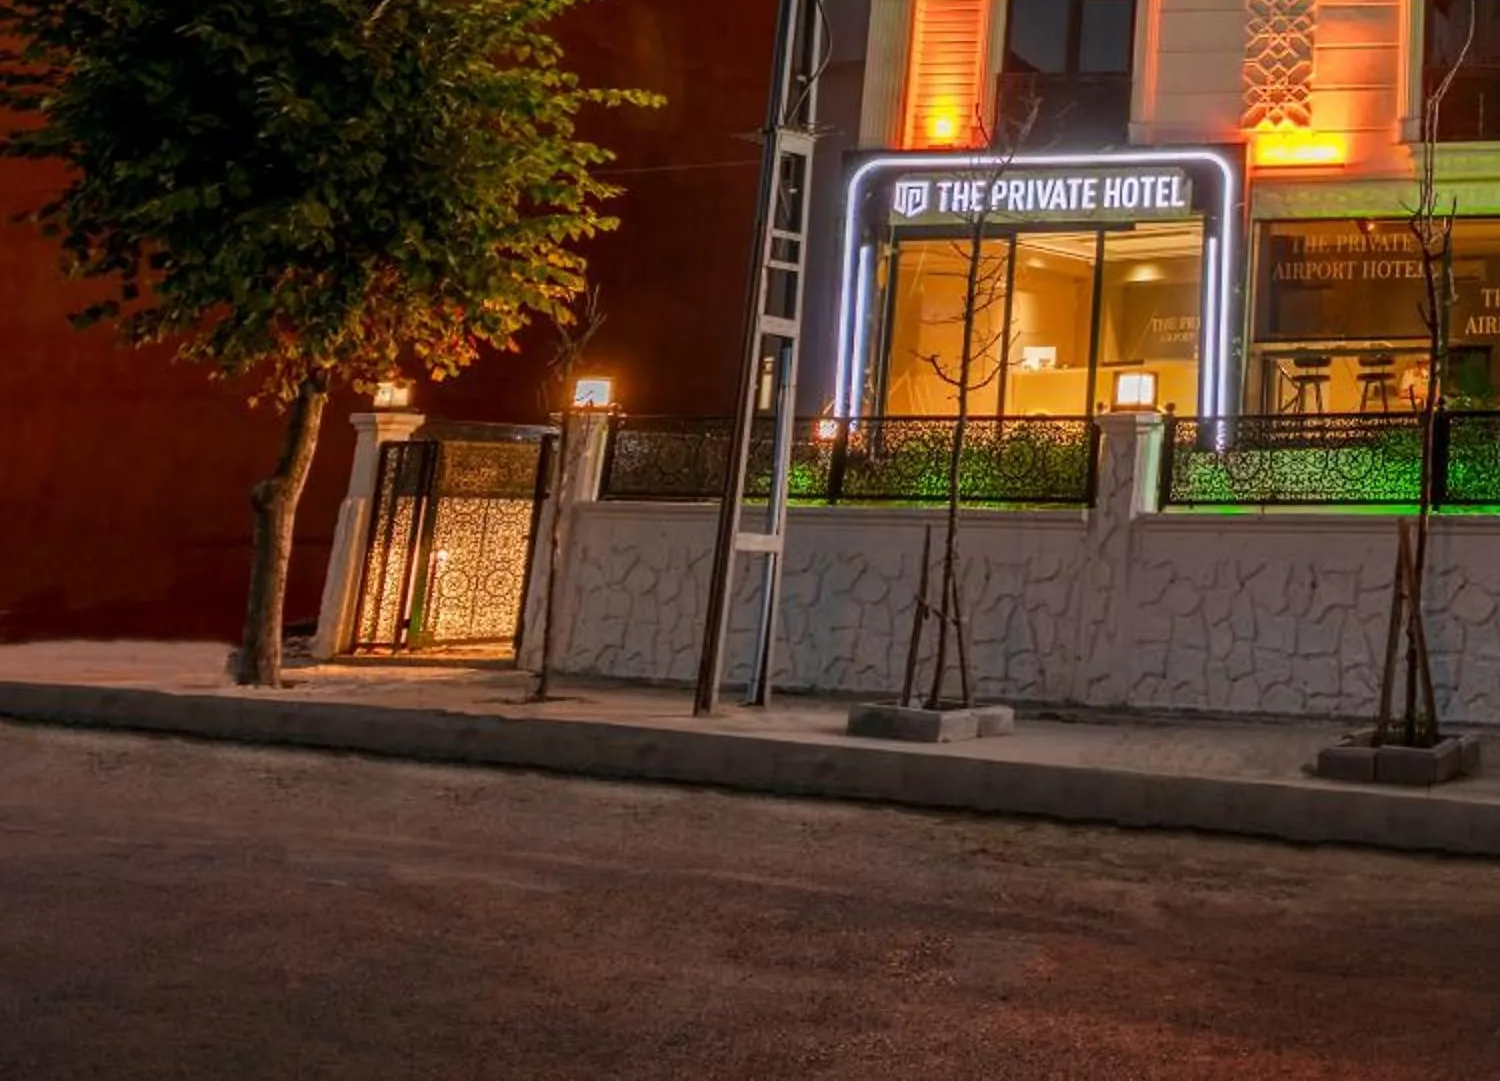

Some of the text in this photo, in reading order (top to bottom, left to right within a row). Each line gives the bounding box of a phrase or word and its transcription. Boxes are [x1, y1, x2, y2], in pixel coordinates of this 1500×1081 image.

[936, 180, 987, 212] THE
[991, 178, 1098, 211] PRIVATE
[1103, 176, 1186, 208] HOTEL
[1290, 233, 1330, 253] THE
[1272, 261, 1357, 280] AIRPORT
